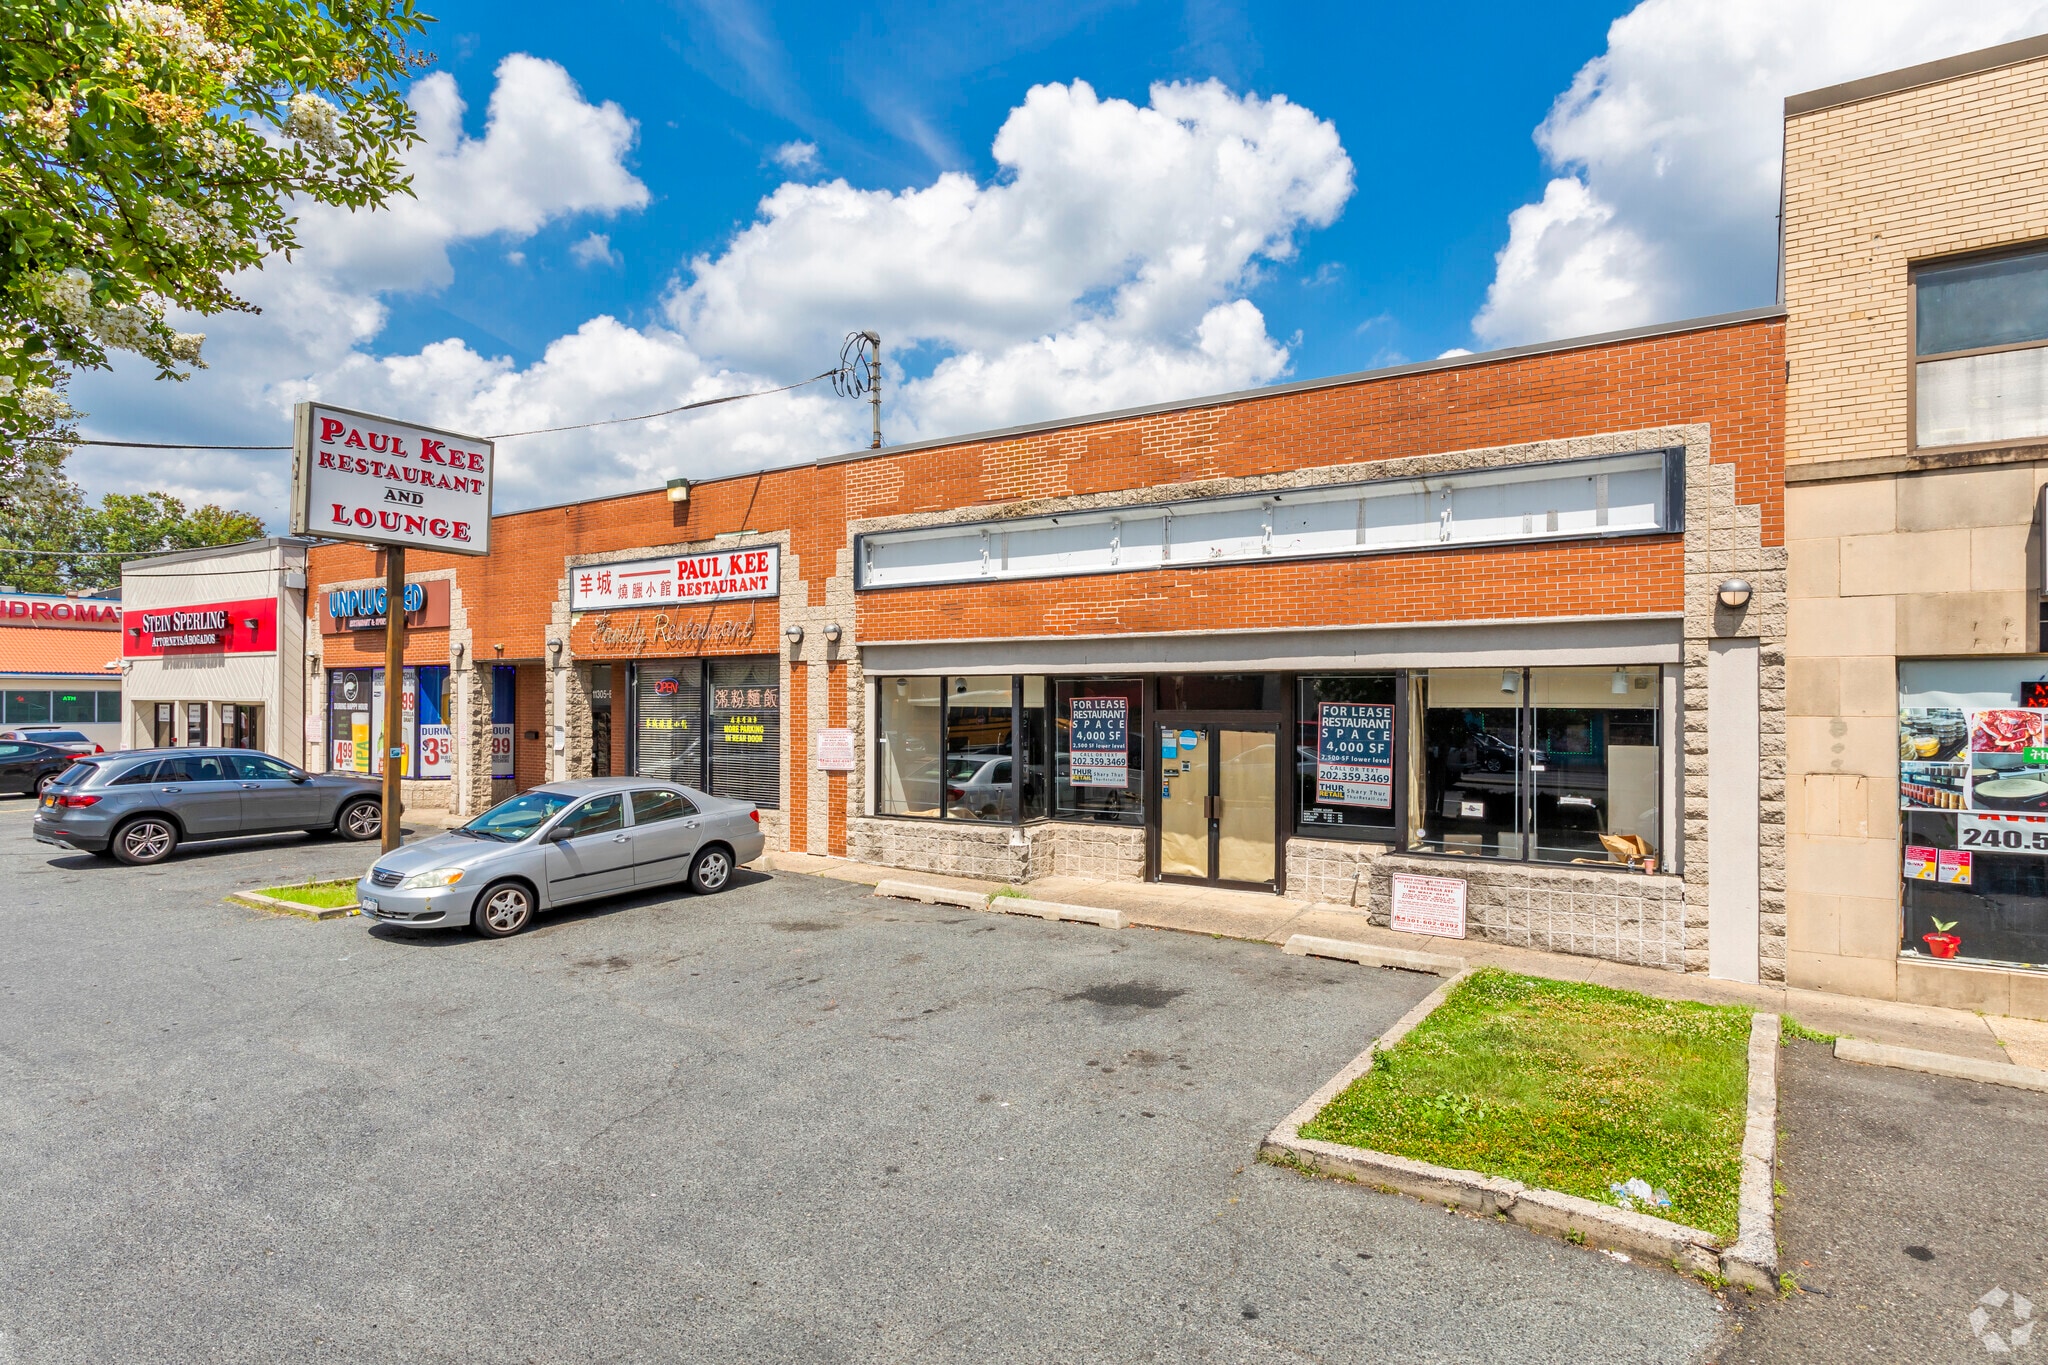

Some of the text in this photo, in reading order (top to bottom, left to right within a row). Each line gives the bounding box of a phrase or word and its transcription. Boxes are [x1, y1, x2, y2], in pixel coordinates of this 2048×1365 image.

[320, 417, 485, 473] PAUL KEE
[318, 451, 485, 495] RESTAURANT
[384, 489, 424, 505] AND
[331, 503, 471, 543] LOUNGE
[677, 551, 769, 581] PAUL KEE
[580, 569, 613, 599] 羊城
[677, 575, 769, 597] RESTAURANT
[329, 583, 424, 618] UNPLUGED
[0, 600, 121, 623] DROMA
[142, 610, 226, 633] STEIN SPERLING
[654, 681, 679, 694] OPEN
[1073, 700, 1126, 709] FOR LEASE
[1073, 710, 1126, 719] RESTAURANT
[1322, 705, 1391, 718] FOR LEASE
[739, 725, 764, 734] PARKING
[1322, 717, 1391, 729] RESTAURANT
[422, 727, 452, 736] DURIN
[492, 727, 511, 735] OUR
[1076, 731, 1121, 741] 4,000 SF
[356, 741, 369, 767] IPA
[1326, 741, 1385, 754] 4,000 SF
[1072, 757, 1126, 766] 202.359.3469
[1320, 770, 1390, 784] 202.359.3469
[1319, 783, 1344, 792] THUR
[1319, 790, 1344, 799] RETAIL
[1963, 828, 2048, 850] 240.5
